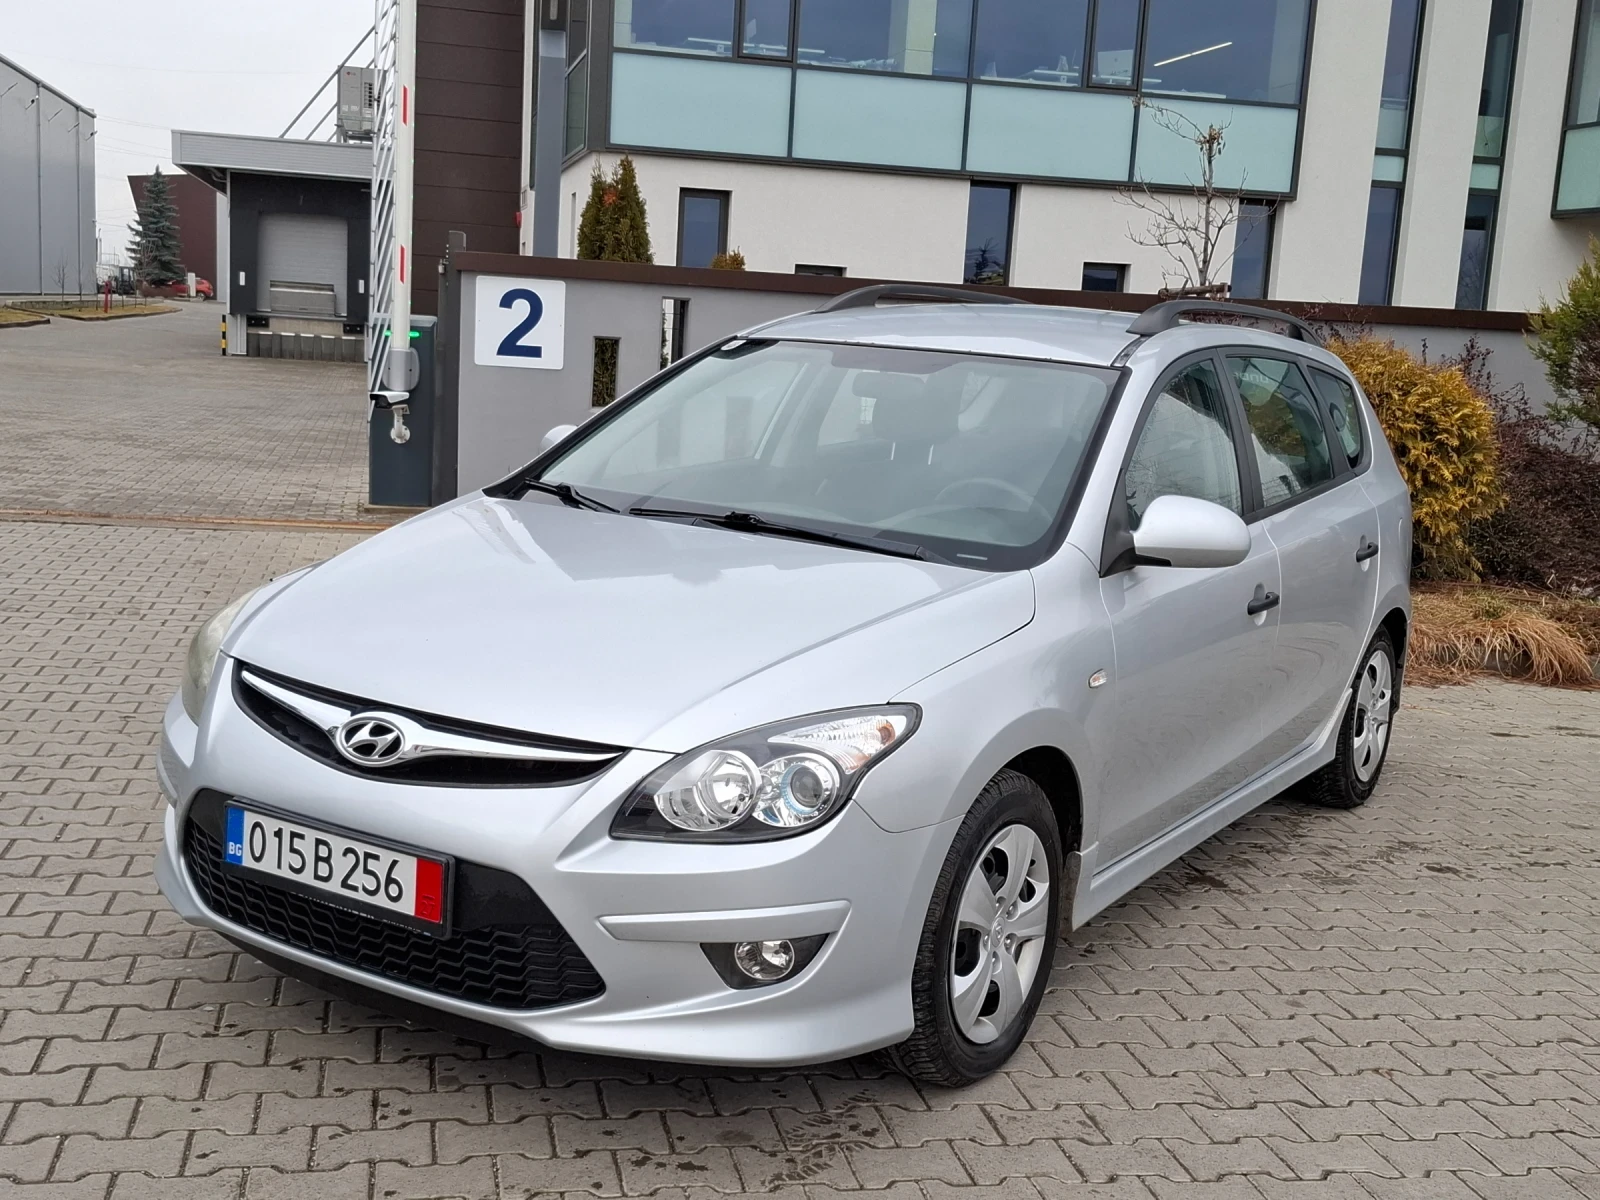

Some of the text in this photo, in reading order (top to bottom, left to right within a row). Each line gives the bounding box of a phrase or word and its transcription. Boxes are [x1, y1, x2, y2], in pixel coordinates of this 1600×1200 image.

[496, 288, 543, 358] 2
[228, 841, 242, 856] BG
[249, 820, 404, 903] 015B256
